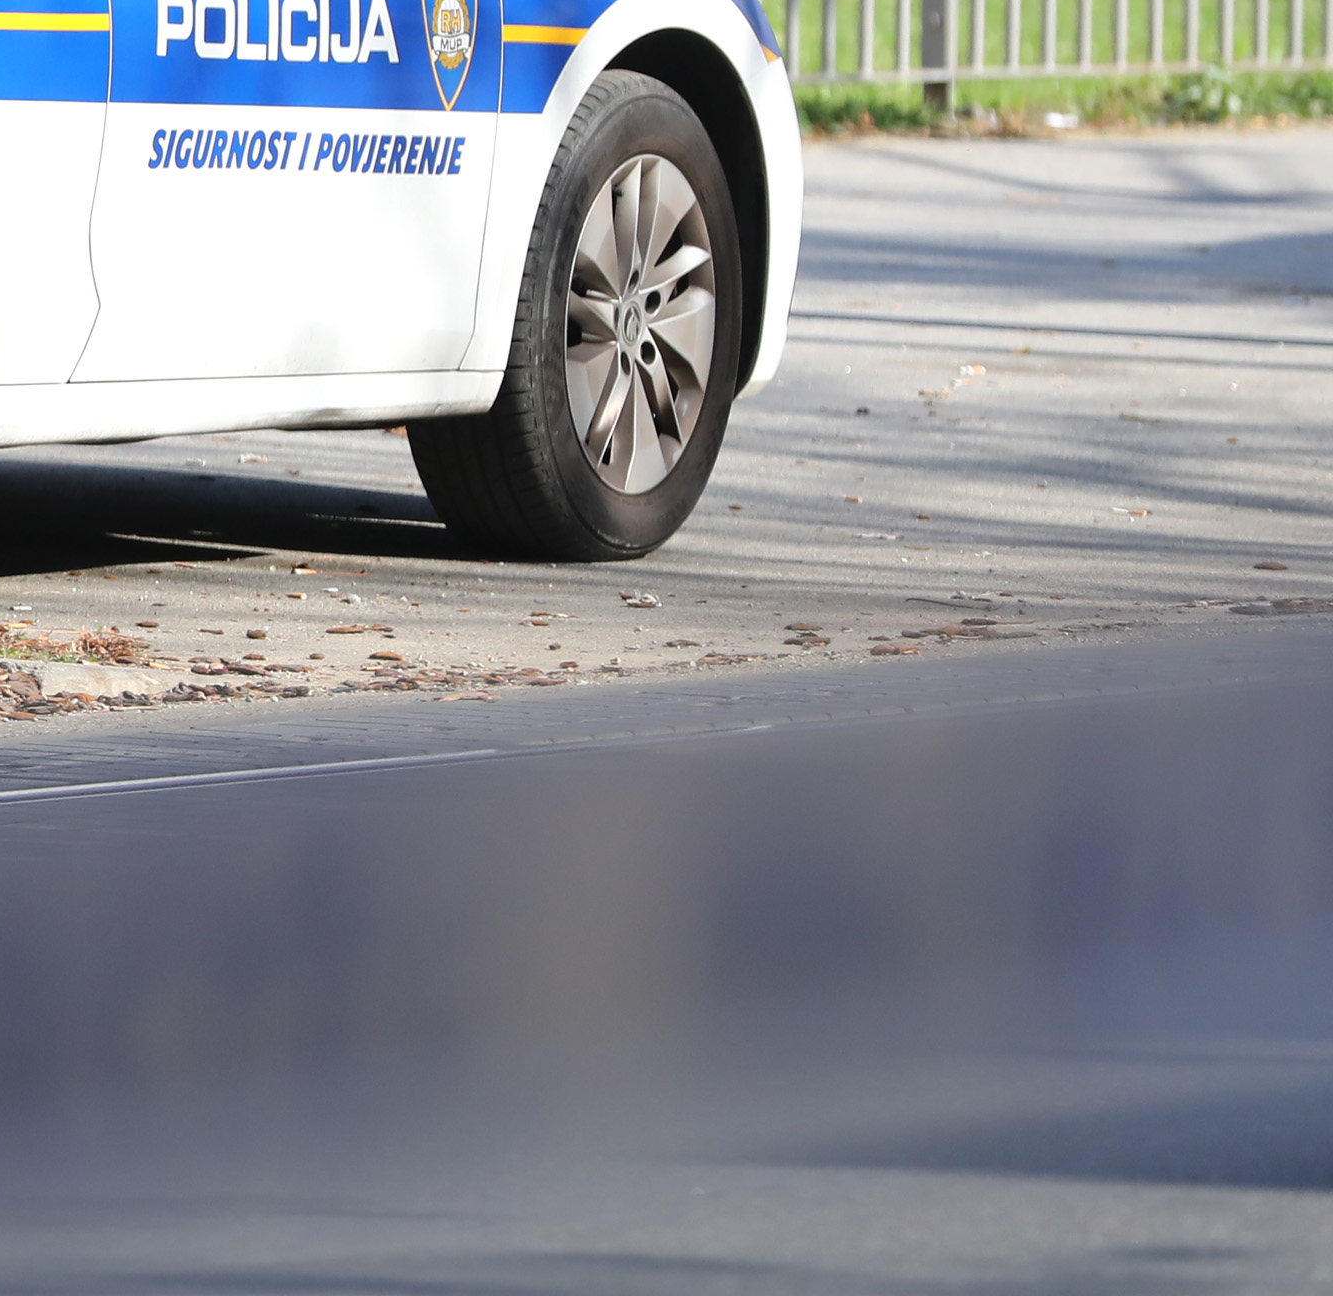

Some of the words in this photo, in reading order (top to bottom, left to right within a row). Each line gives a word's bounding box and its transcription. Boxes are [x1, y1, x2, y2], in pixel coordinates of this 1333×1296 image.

[440, 9, 462, 34] RH
[440, 37, 463, 51] MUP
[148, 129, 297, 171] SIGURNOST
[298, 132, 311, 171] I
[314, 133, 466, 175] POVJERENJE
